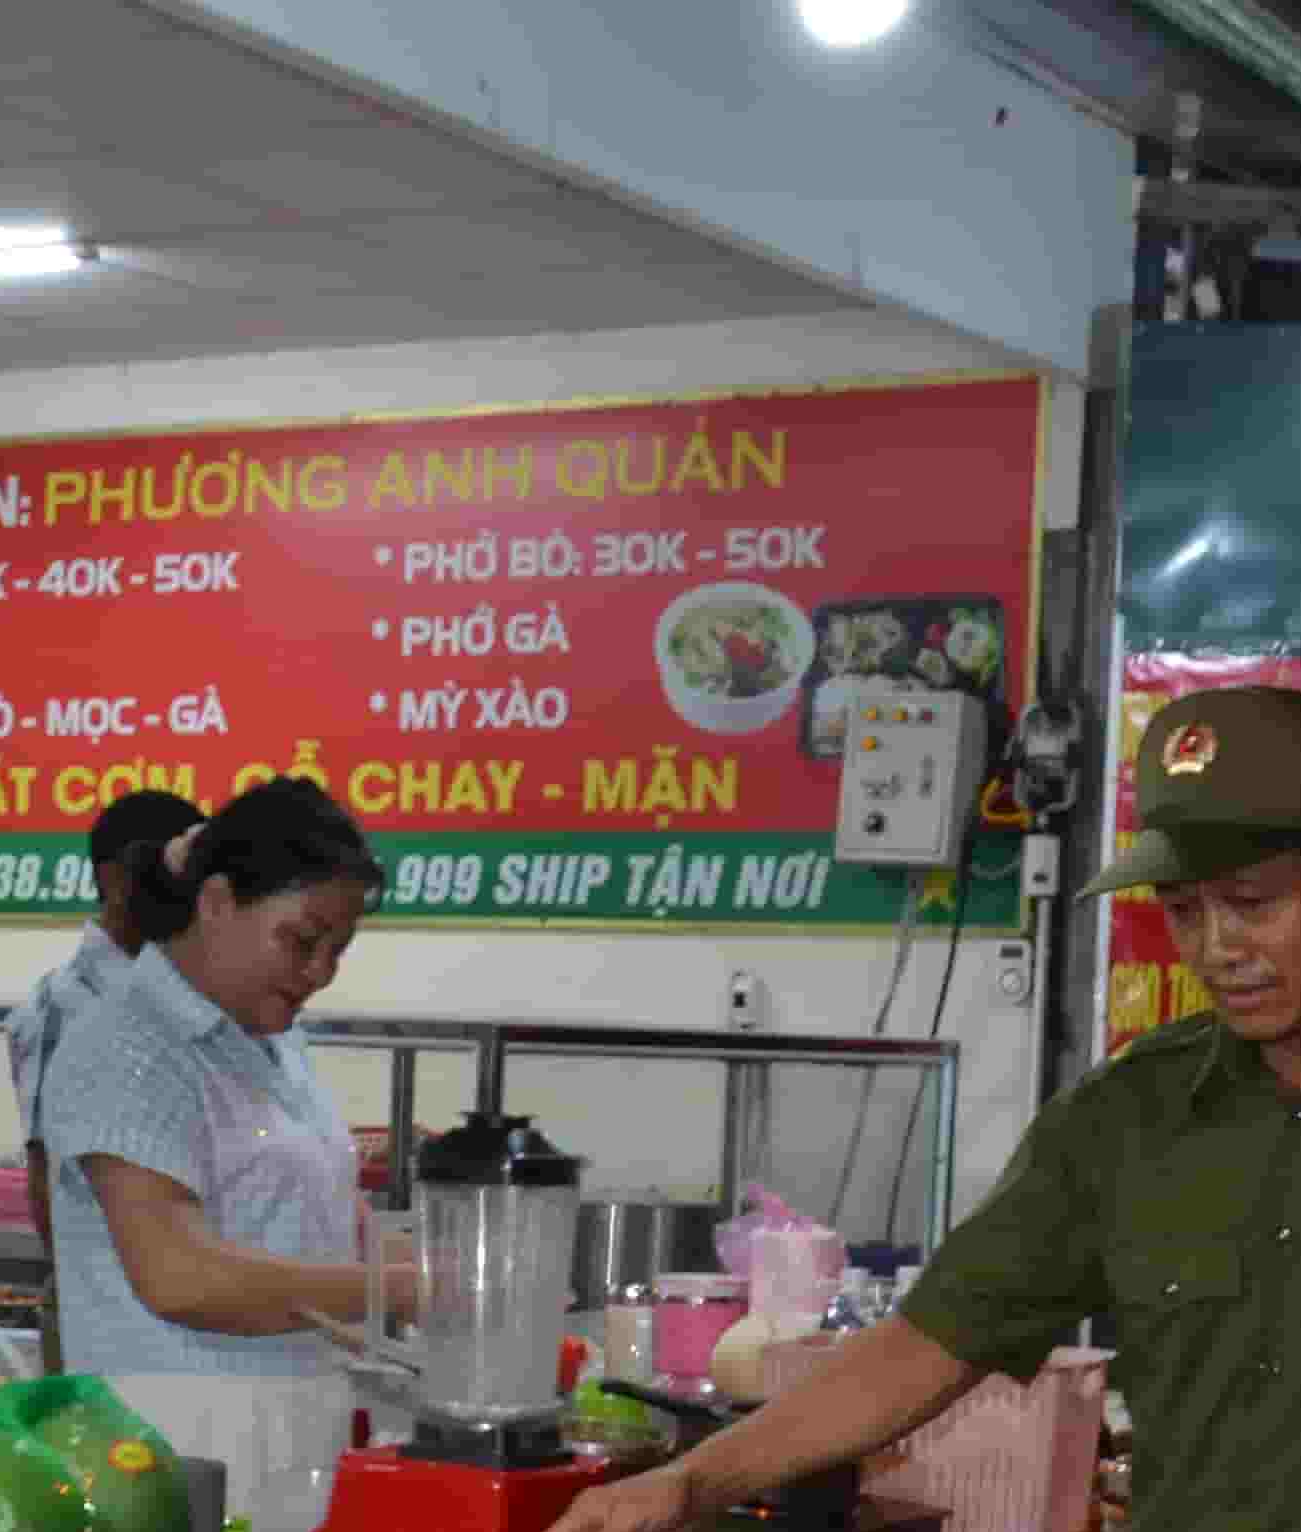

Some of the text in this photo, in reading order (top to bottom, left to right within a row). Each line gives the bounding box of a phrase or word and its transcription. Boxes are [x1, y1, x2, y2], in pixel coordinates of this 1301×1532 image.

[44, 448, 349, 526] PHƯƠNG
[368, 441, 532, 507] ANH
[556, 416, 788, 500] QUÁN
[38, 557, 124, 599] 40K
[154, 551, 241, 594] 50K
[402, 529, 500, 584] PHỞ
[592, 531, 688, 576] 30K
[724, 525, 826, 570] 50K
[400, 600, 570, 657] PHỞ GÀ
[45, 697, 139, 746] MỌC
[169, 683, 229, 735] GÀ
[474, 676, 569, 729] XÀO
[347, 758, 524, 815] CHAY
[582, 744, 740, 831] MẶN
[494, 852, 611, 907] SHIP
[626, 844, 725, 917] TẬN
[734, 849, 832, 909] NƠI
